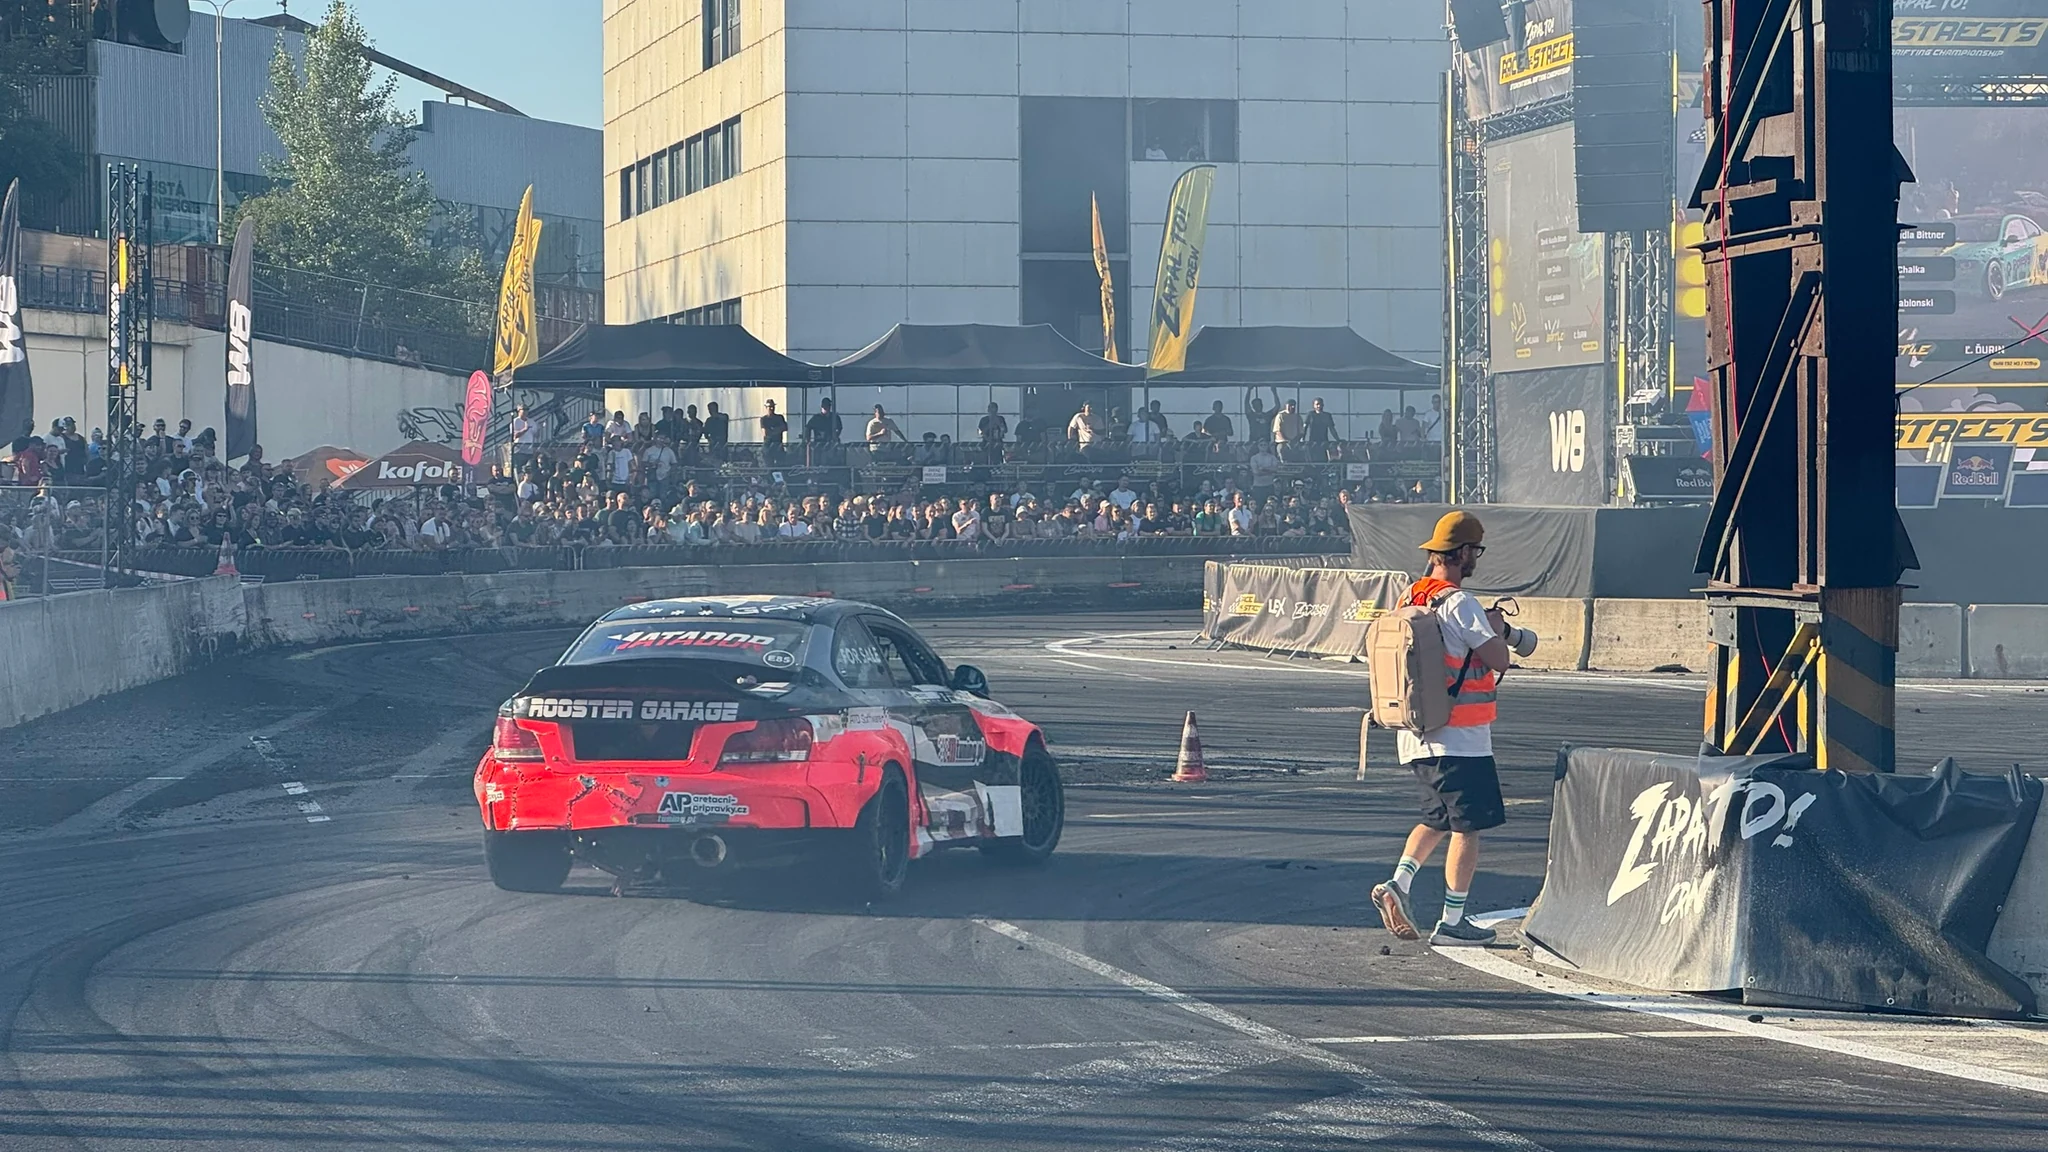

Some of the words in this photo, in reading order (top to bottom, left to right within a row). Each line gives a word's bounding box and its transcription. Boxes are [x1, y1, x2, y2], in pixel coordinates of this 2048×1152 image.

[1894, 21, 2043, 43] STREETS
[1532, 39, 1573, 70] STREET
[1932, 48, 2005, 57] CHAMPIONSHIP
[148, 180, 186, 198] ISTÁ
[1916, 230, 1946, 240] Bittner
[1185, 244, 1200, 290] CREW
[1157, 250, 1184, 338] ZAPAL
[1898, 298, 1934, 308] ablonski
[1676, 478, 1696, 488] Red
[1697, 478, 1713, 488] Bu
[1952, 472, 1976, 485] Red
[1977, 472, 1999, 485] Bull
[1268, 597, 1287, 618] LEX
[607, 630, 776, 653] MATADOR
[767, 655, 791, 664] E85
[861, 646, 882, 664] SALE
[528, 697, 634, 719] ROOSTER
[640, 699, 740, 722] GARAGE
[659, 793, 692, 812] AP
[692, 804, 748, 815] pripravky.cz
[1607, 781, 1707, 907] ZAPA
[1704, 772, 1817, 849] TO!
